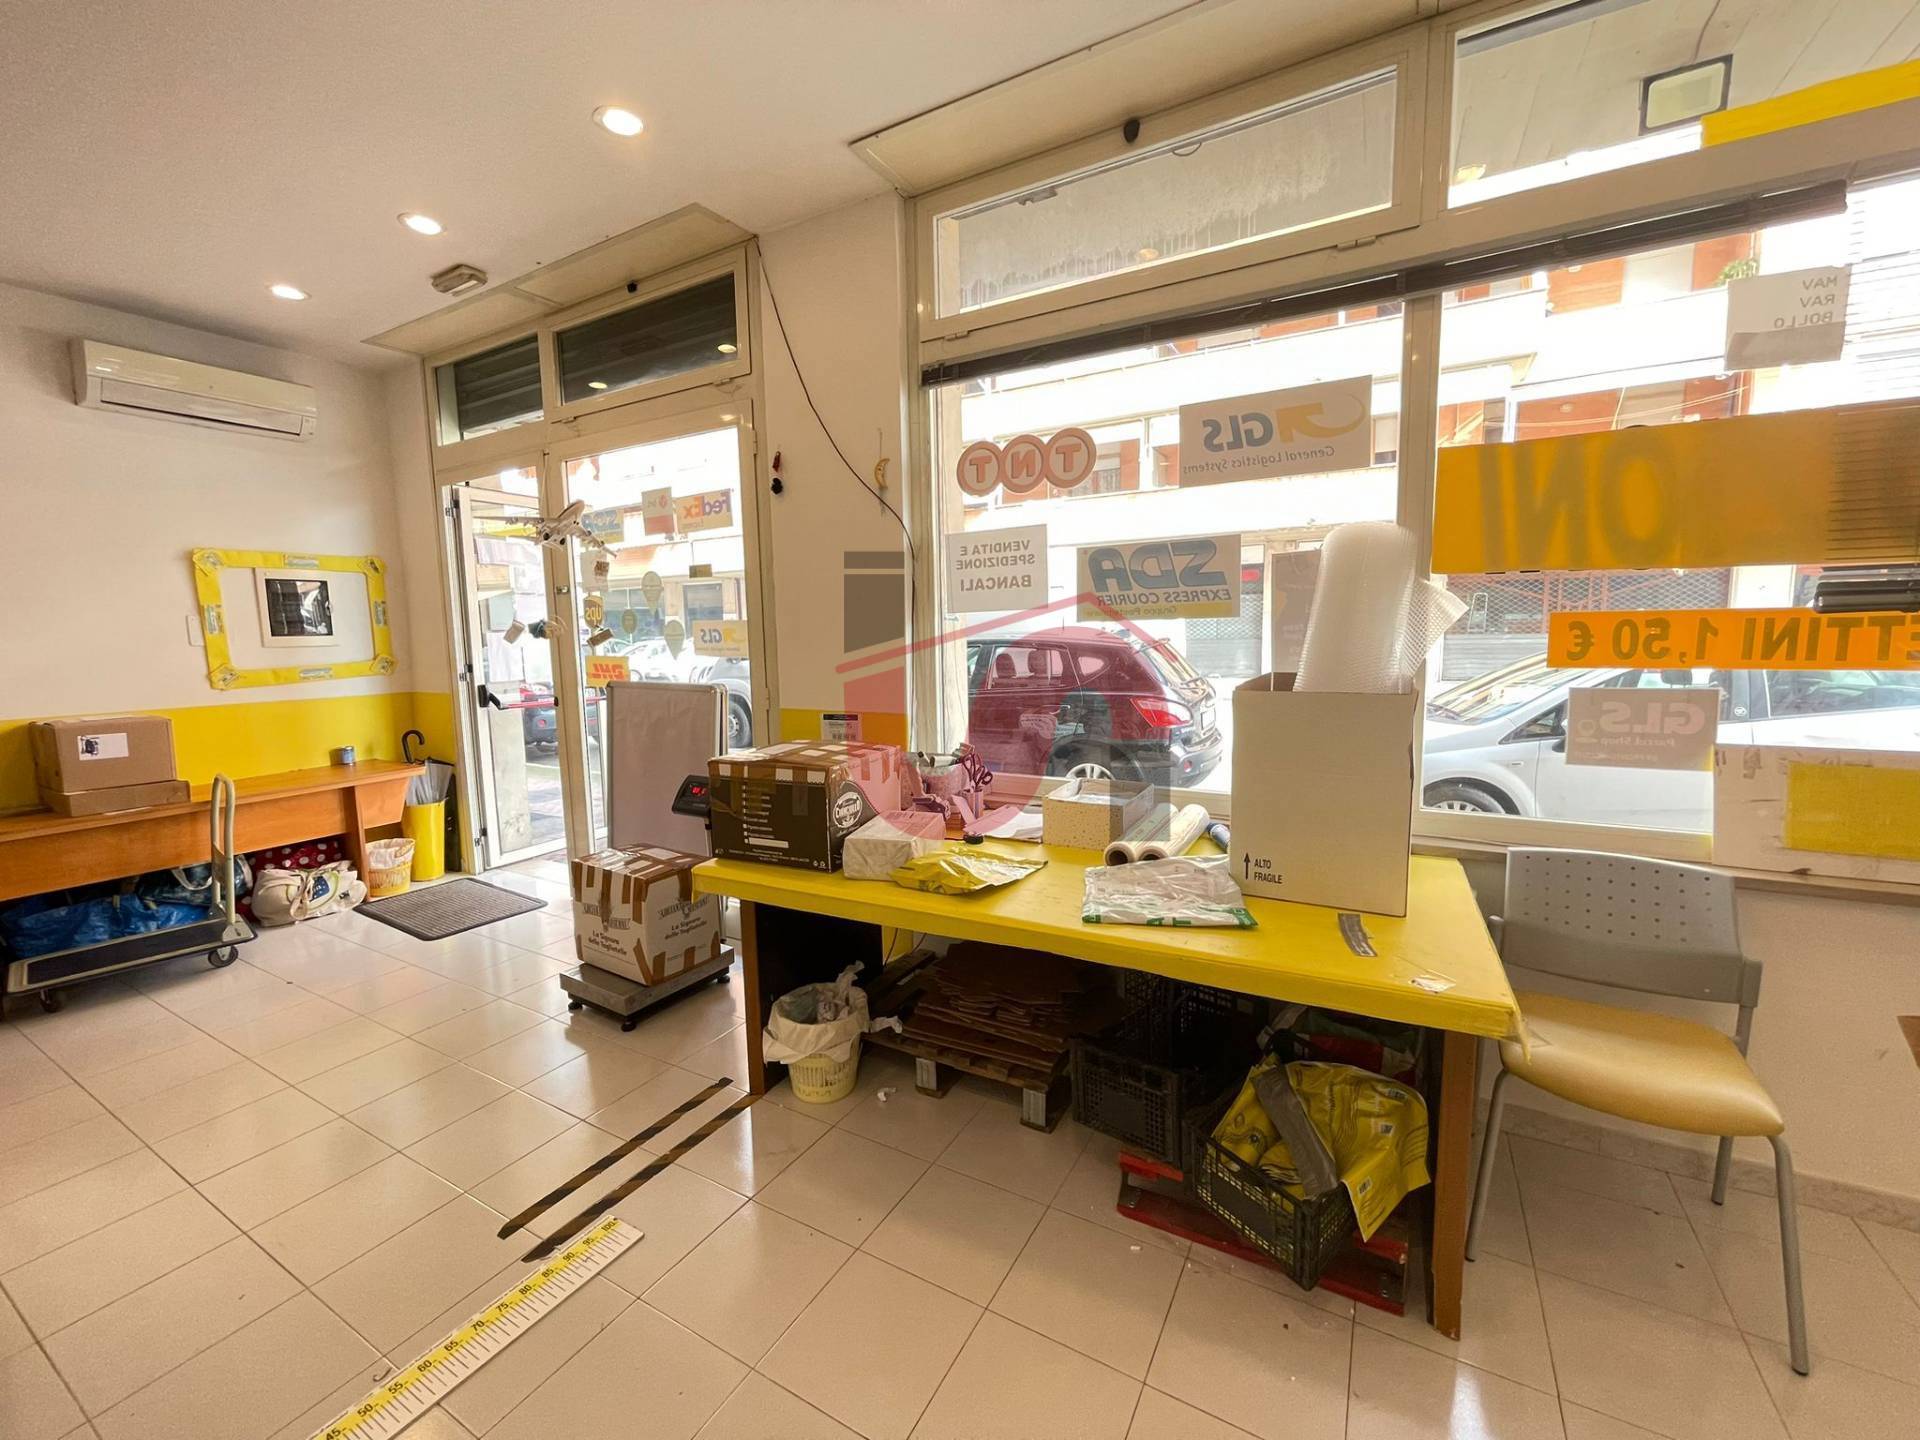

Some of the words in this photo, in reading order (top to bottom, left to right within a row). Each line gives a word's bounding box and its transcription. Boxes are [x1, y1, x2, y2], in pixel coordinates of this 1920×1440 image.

[1254, 858, 1272, 869] ALTO
[1253, 871, 1283, 885] FRAGILE
[601, 1221, 616, 1232] 100
[582, 1237, 595, 1246] 95
[562, 1251, 576, 1262] 90
[541, 1268, 555, 1279] 85
[518, 1284, 533, 1296] 80
[495, 1301, 510, 1313] 75
[470, 1320, 486, 1332] 70
[443, 1340, 459, 1352] 65
[416, 1359, 433, 1373] 60
[387, 1381, 404, 1395] 55
[356, 1403, 374, 1418] 50
[325, 1427, 342, 1440] 45
